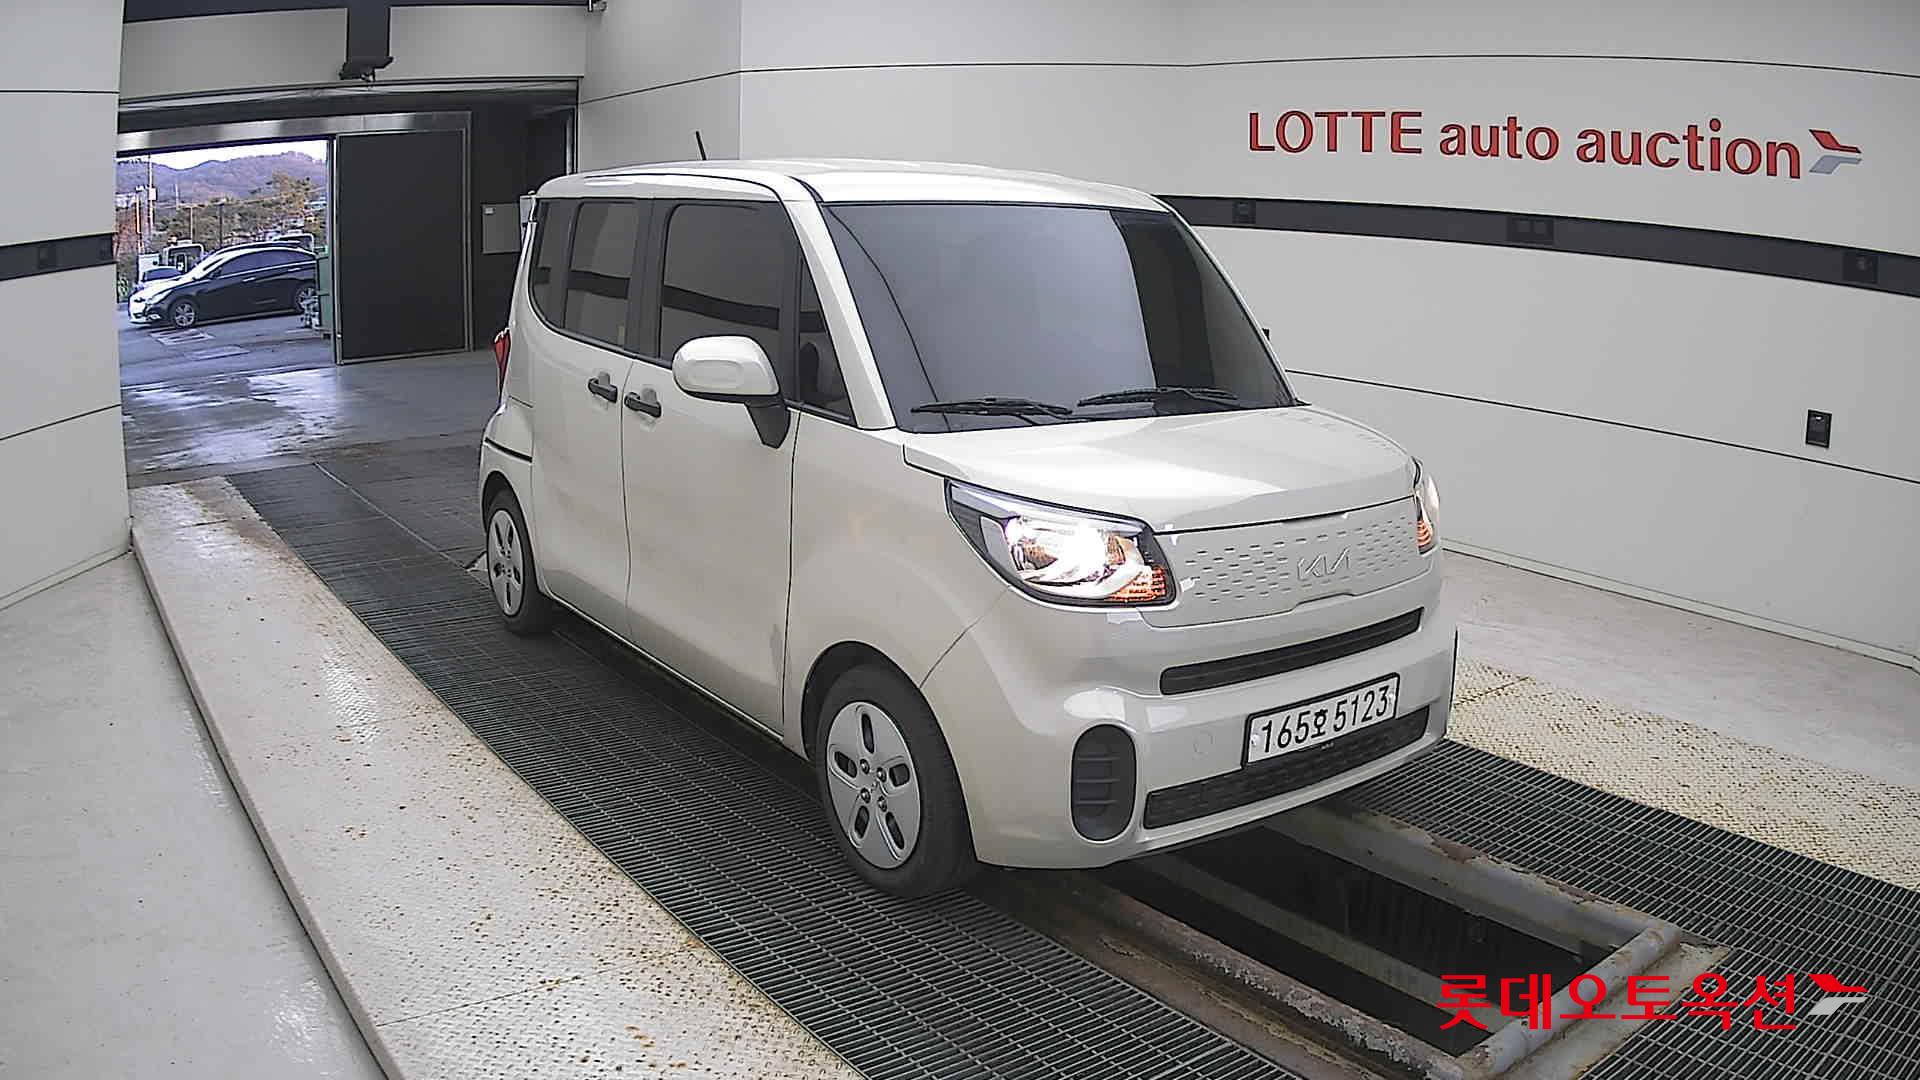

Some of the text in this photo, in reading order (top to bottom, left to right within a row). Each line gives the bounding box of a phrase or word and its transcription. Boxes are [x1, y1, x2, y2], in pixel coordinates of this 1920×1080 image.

[1249, 111, 1801, 179] LOTTE auto auction
[1297, 546, 1351, 580] KIA
[1332, 684, 1391, 733] 5123
